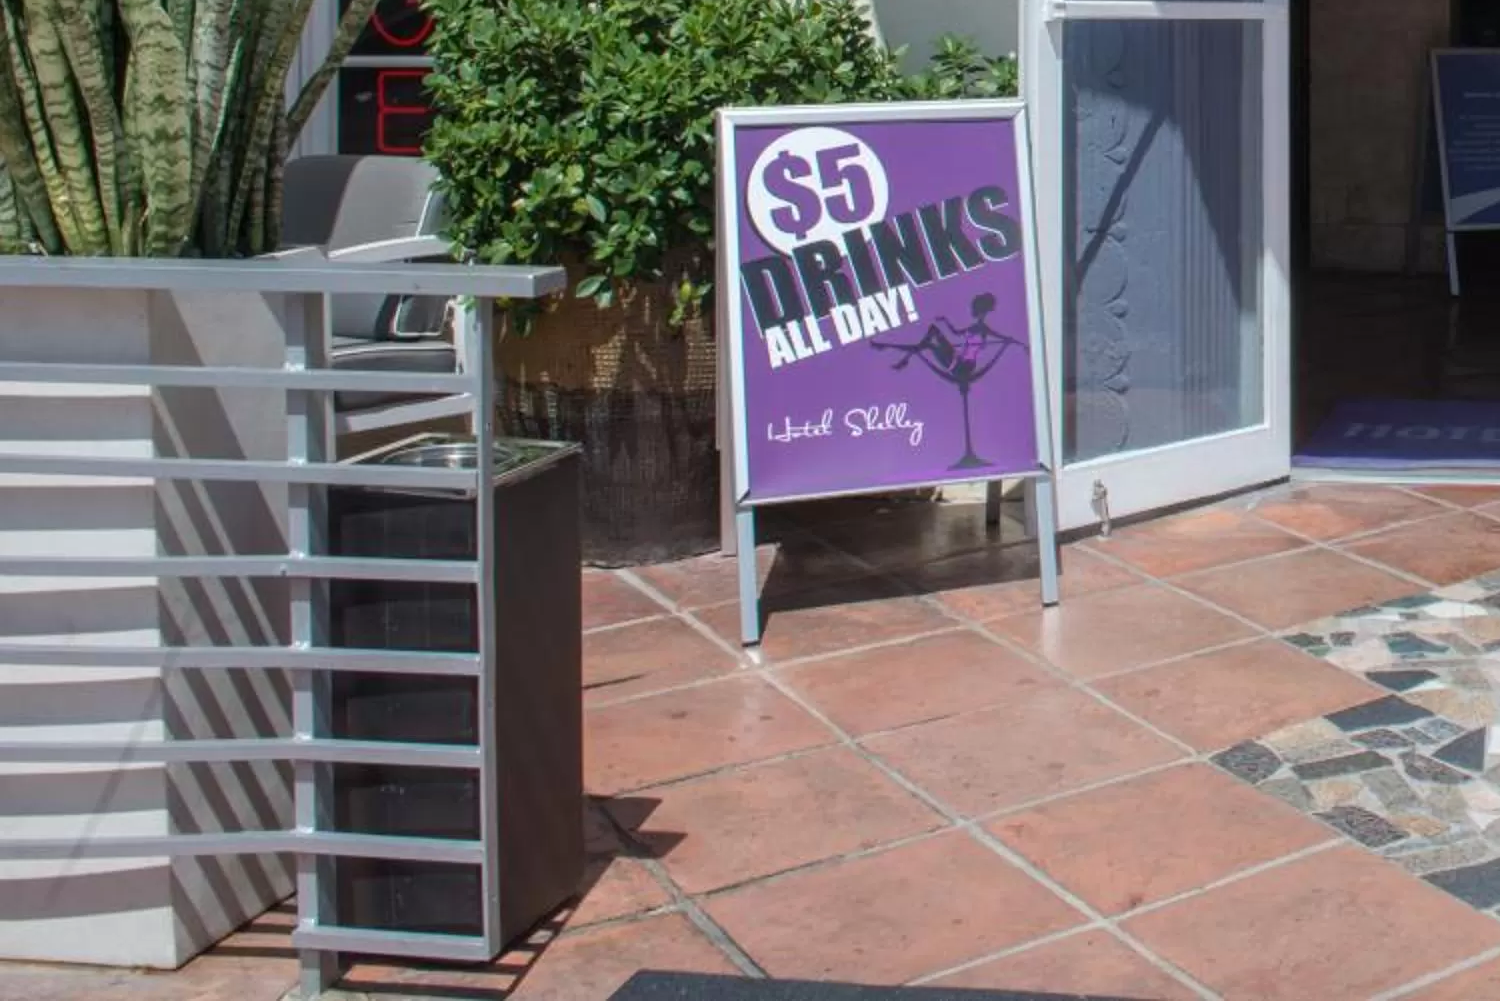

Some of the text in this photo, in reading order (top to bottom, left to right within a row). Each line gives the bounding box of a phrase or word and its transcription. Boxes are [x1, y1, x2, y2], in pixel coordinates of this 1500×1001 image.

[763, 143, 875, 240] $5
[740, 185, 1023, 335] DRINKS
[763, 285, 919, 369] ALL DAY!
[767, 408, 833, 442] Hotel
